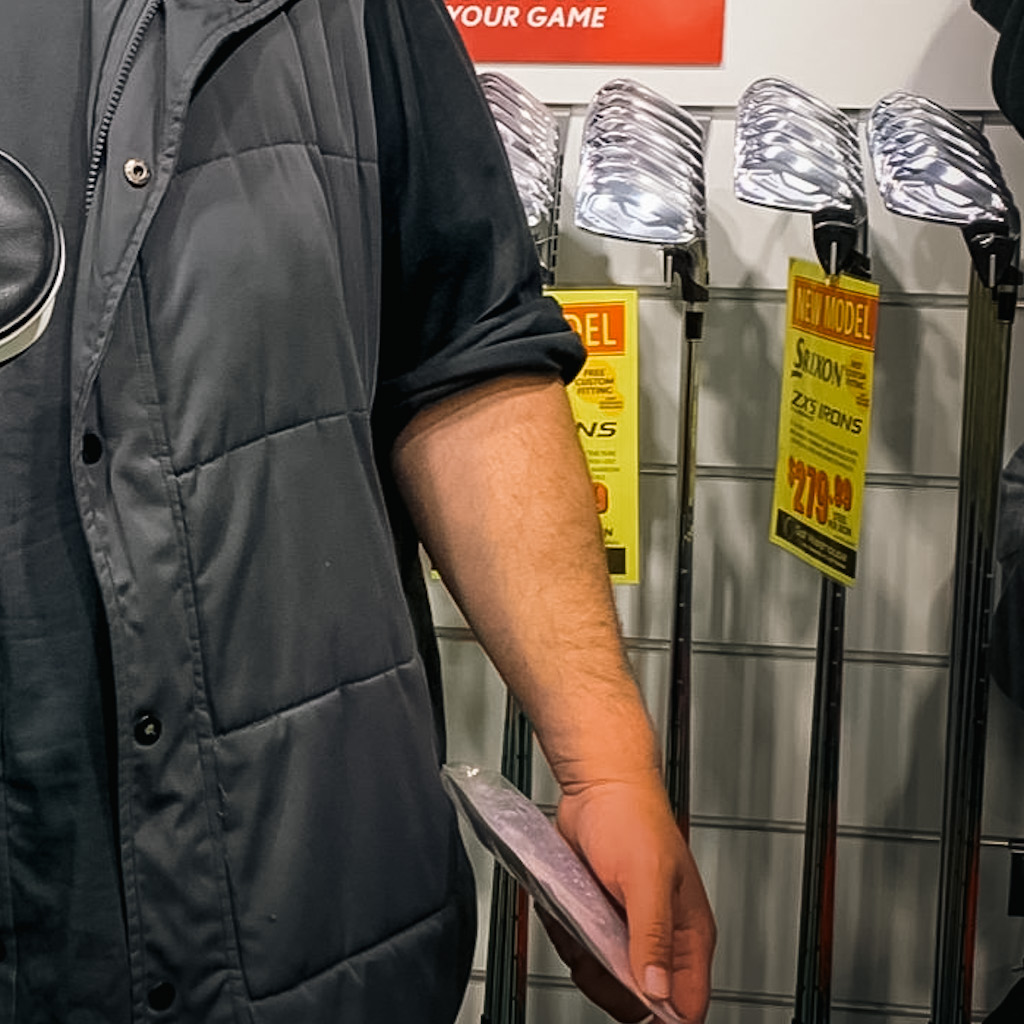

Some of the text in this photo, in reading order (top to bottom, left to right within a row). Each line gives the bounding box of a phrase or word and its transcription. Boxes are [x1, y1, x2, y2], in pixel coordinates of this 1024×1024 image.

[446, 5, 607, 28] YOUR GAME
[796, 287, 872, 340] NEW MODEL
[793, 337, 843, 388] SRIXON
[818, 403, 863, 434] IRONS
